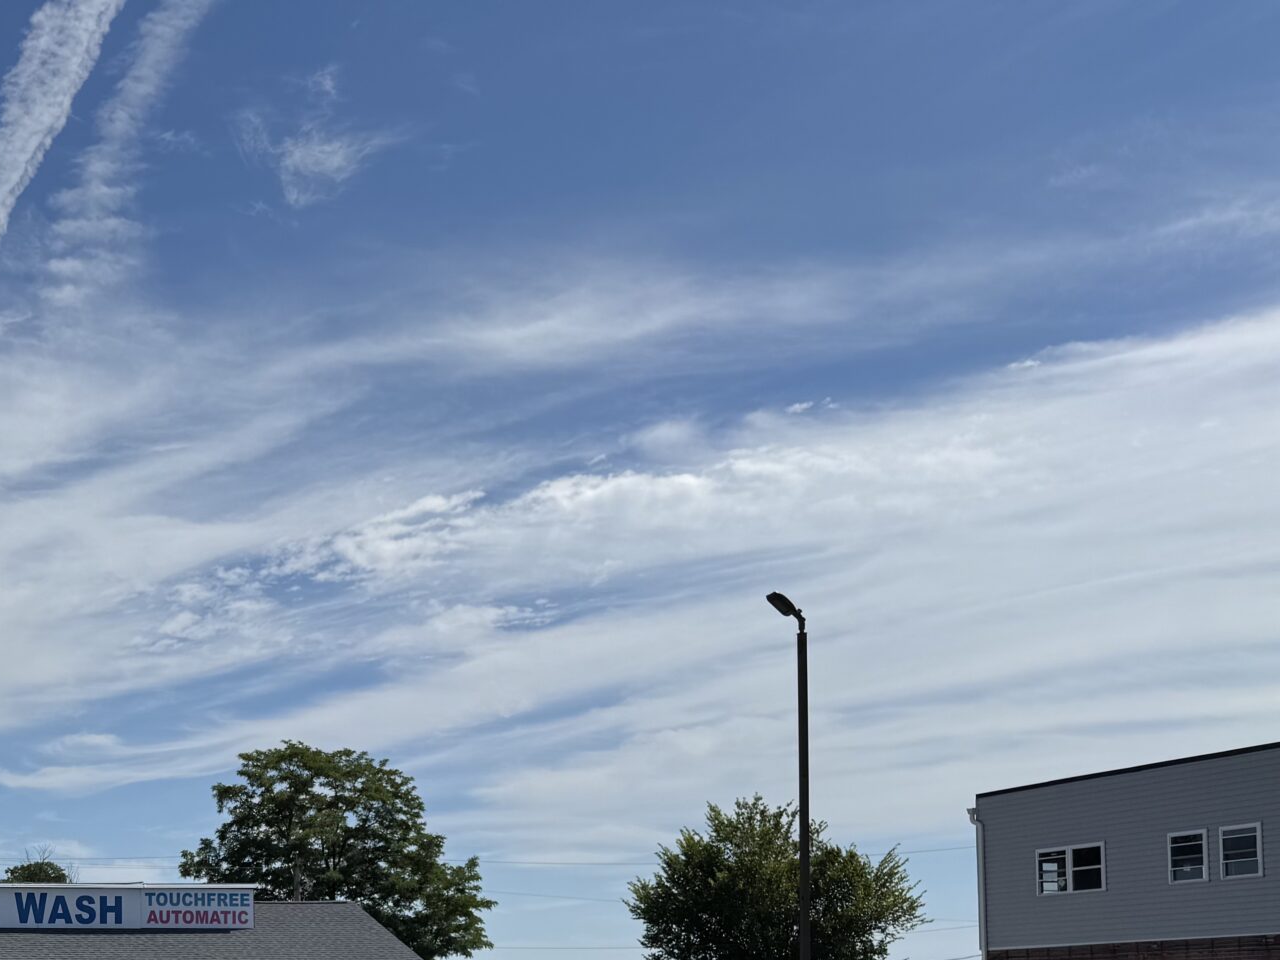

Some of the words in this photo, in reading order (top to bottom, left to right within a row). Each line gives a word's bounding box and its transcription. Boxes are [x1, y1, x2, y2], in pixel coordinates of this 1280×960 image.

[144, 892, 250, 907] TOUCHFREE
[14, 891, 123, 925] WASH
[146, 910, 249, 925] AUTOMATIC
